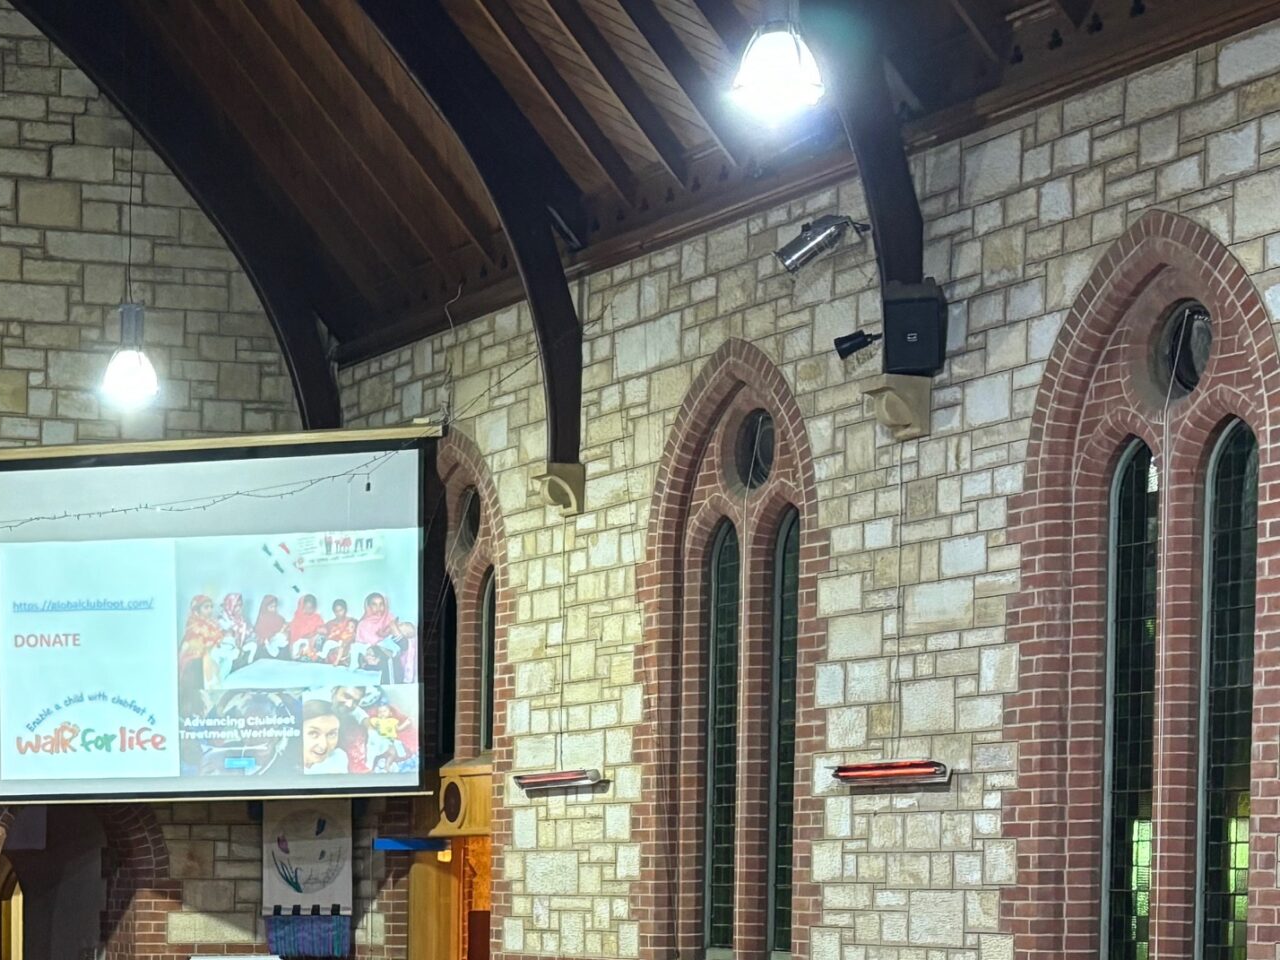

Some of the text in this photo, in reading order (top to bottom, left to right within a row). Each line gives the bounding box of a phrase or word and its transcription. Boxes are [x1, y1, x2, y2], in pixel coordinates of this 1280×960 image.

[14, 633, 81, 648] DONATE
[26, 708, 53, 732] Enable
[64, 692, 85, 707] child
[88, 692, 108, 702] with
[111, 695, 147, 716] clubfoot
[147, 714, 156, 726] to
[184, 715, 296, 728] Advancing Clubfoot
[80, 727, 117, 752] for
[119, 726, 167, 752] life
[180, 728, 300, 740] Treatment Worldwide
